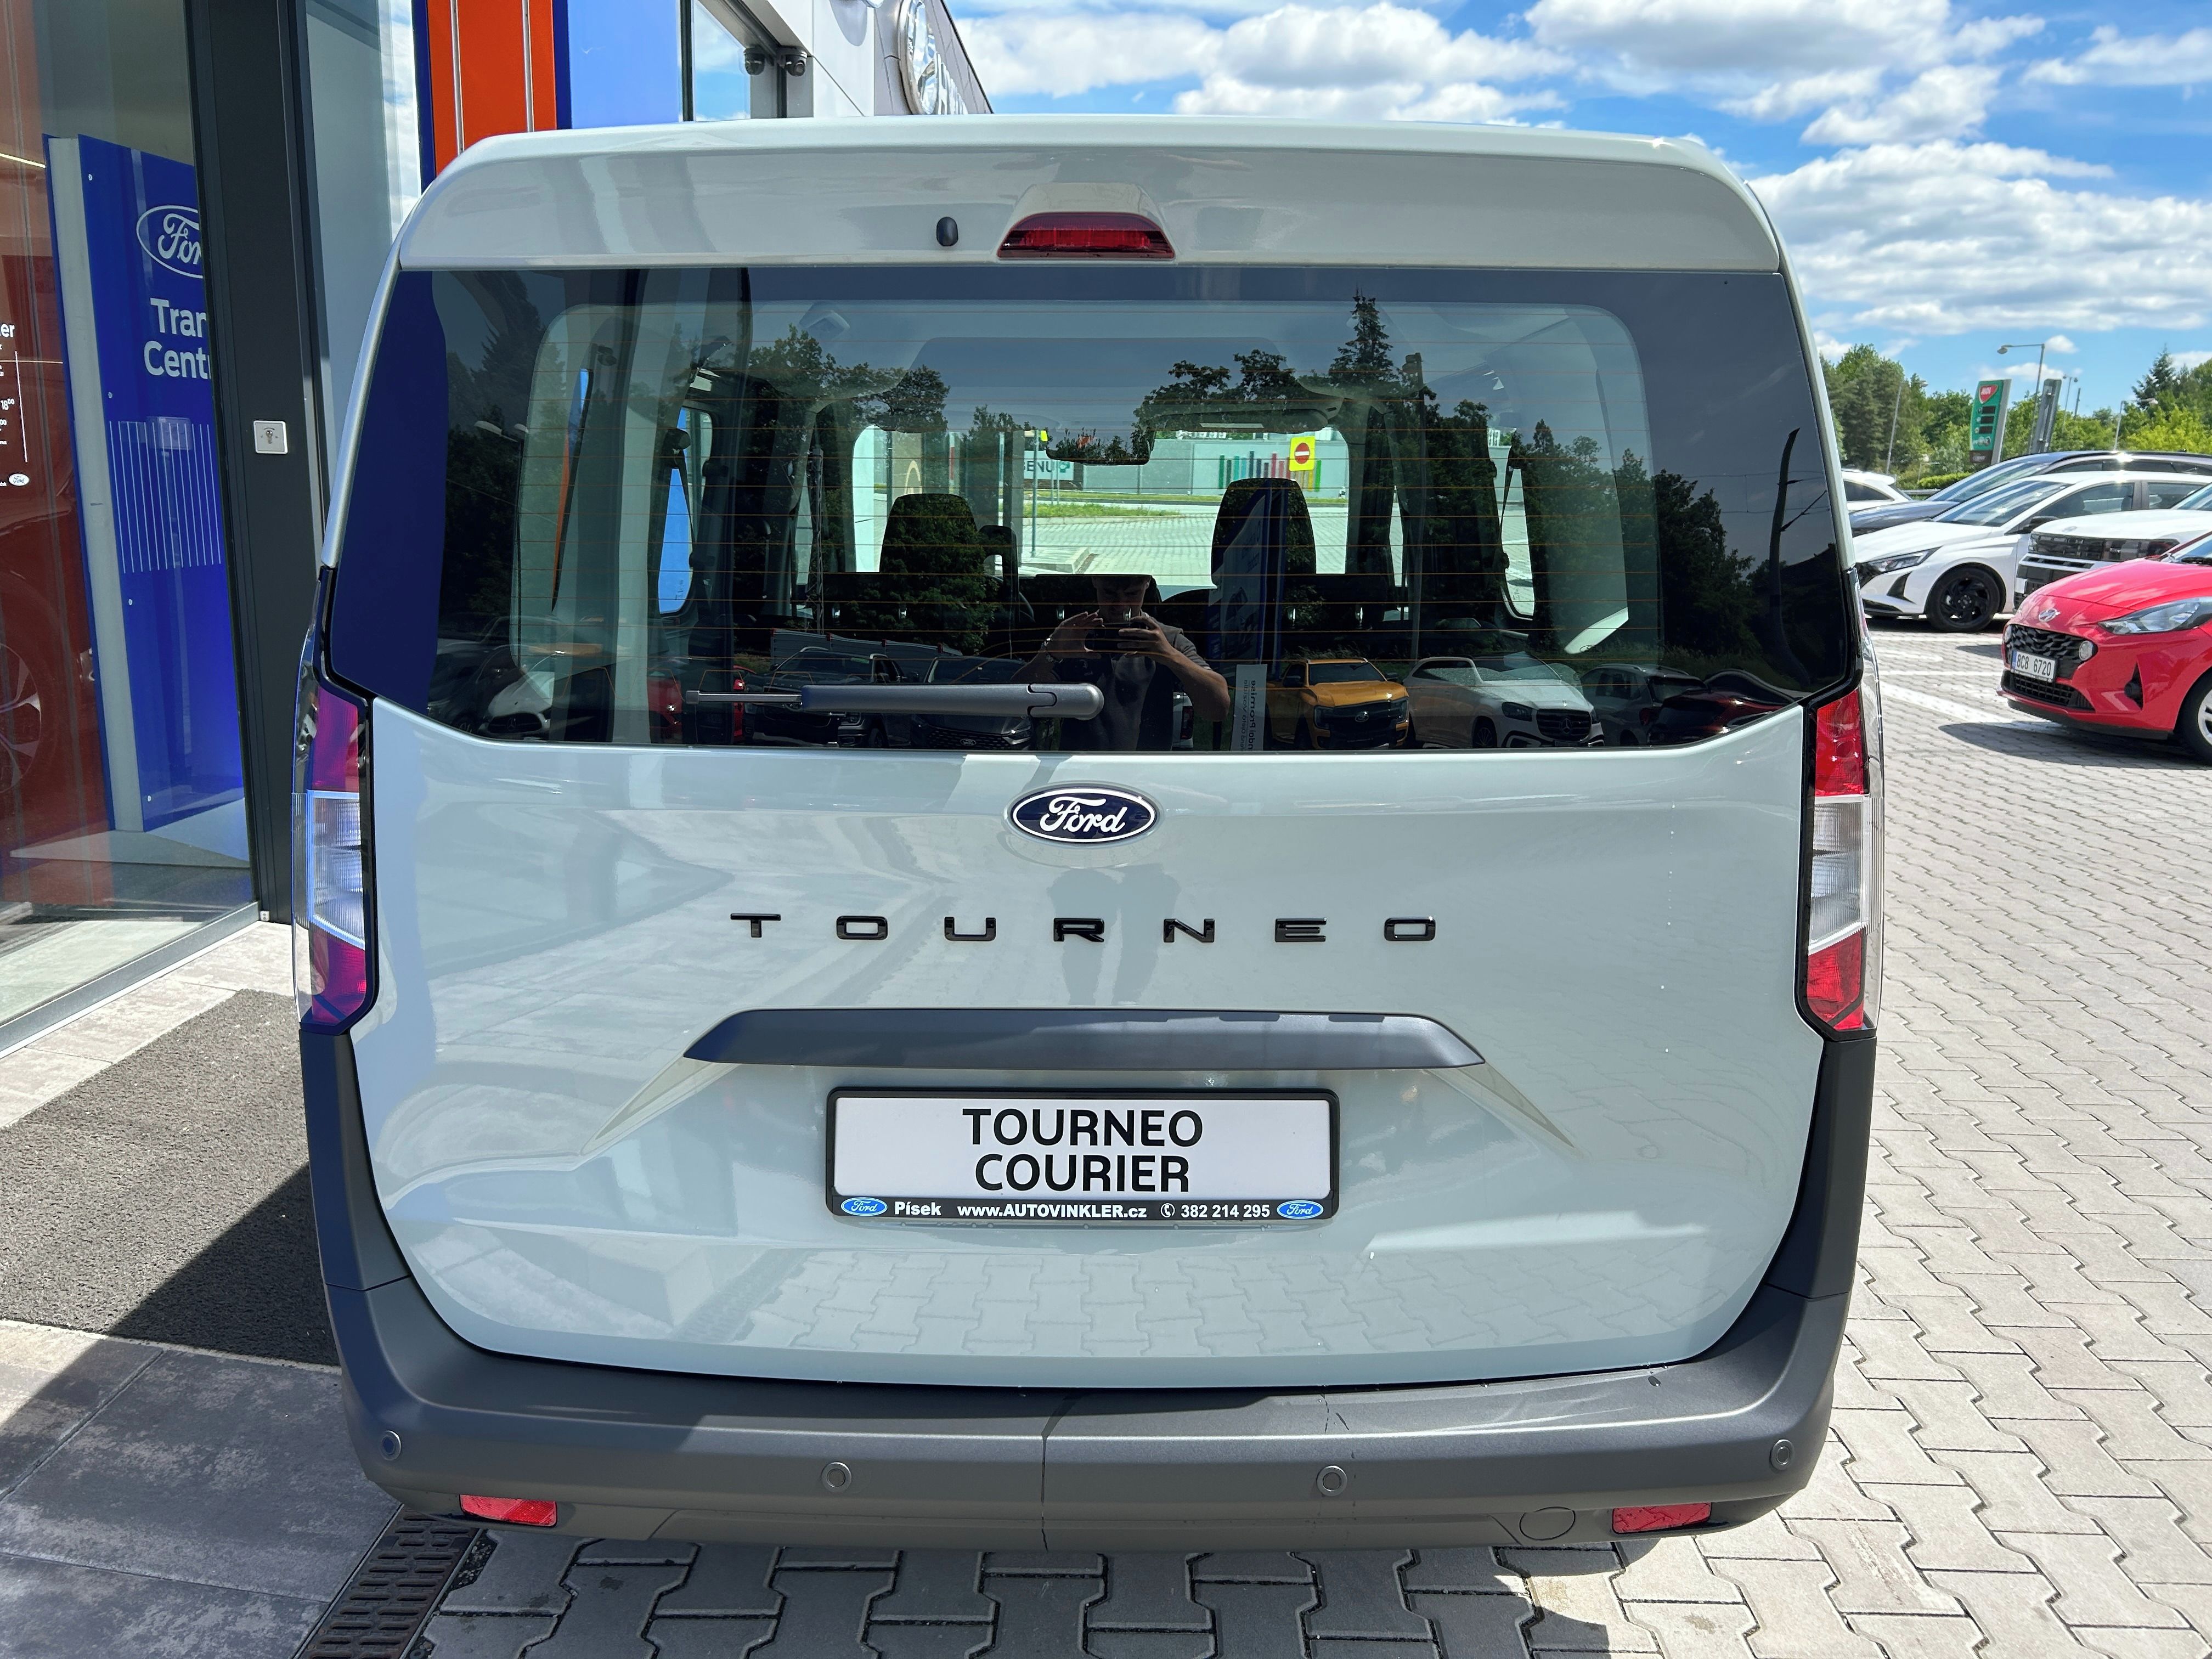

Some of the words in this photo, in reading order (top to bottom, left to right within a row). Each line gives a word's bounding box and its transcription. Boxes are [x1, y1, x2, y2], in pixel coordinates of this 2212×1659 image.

[1024, 461, 1054, 472] ENU
[2017, 654, 2029, 669] 8C8
[2034, 658, 2051, 676] 6720
[1040, 797, 1128, 833] Ford
[730, 913, 1436, 943] TOURNEO
[962, 1108, 1203, 1147] TOURNEO
[976, 1154, 1189, 1192] COURIER
[851, 1200, 877, 1212] Ford
[895, 1201, 941, 1215] Písek
[957, 1203, 1147, 1218] www.AUTOVINKLER.cz
[1181, 1204, 1207, 1218] 382
[1212, 1204, 1239, 1218] 214
[1243, 1204, 1270, 1218] 295
[1286, 1204, 1313, 1215] Ford
